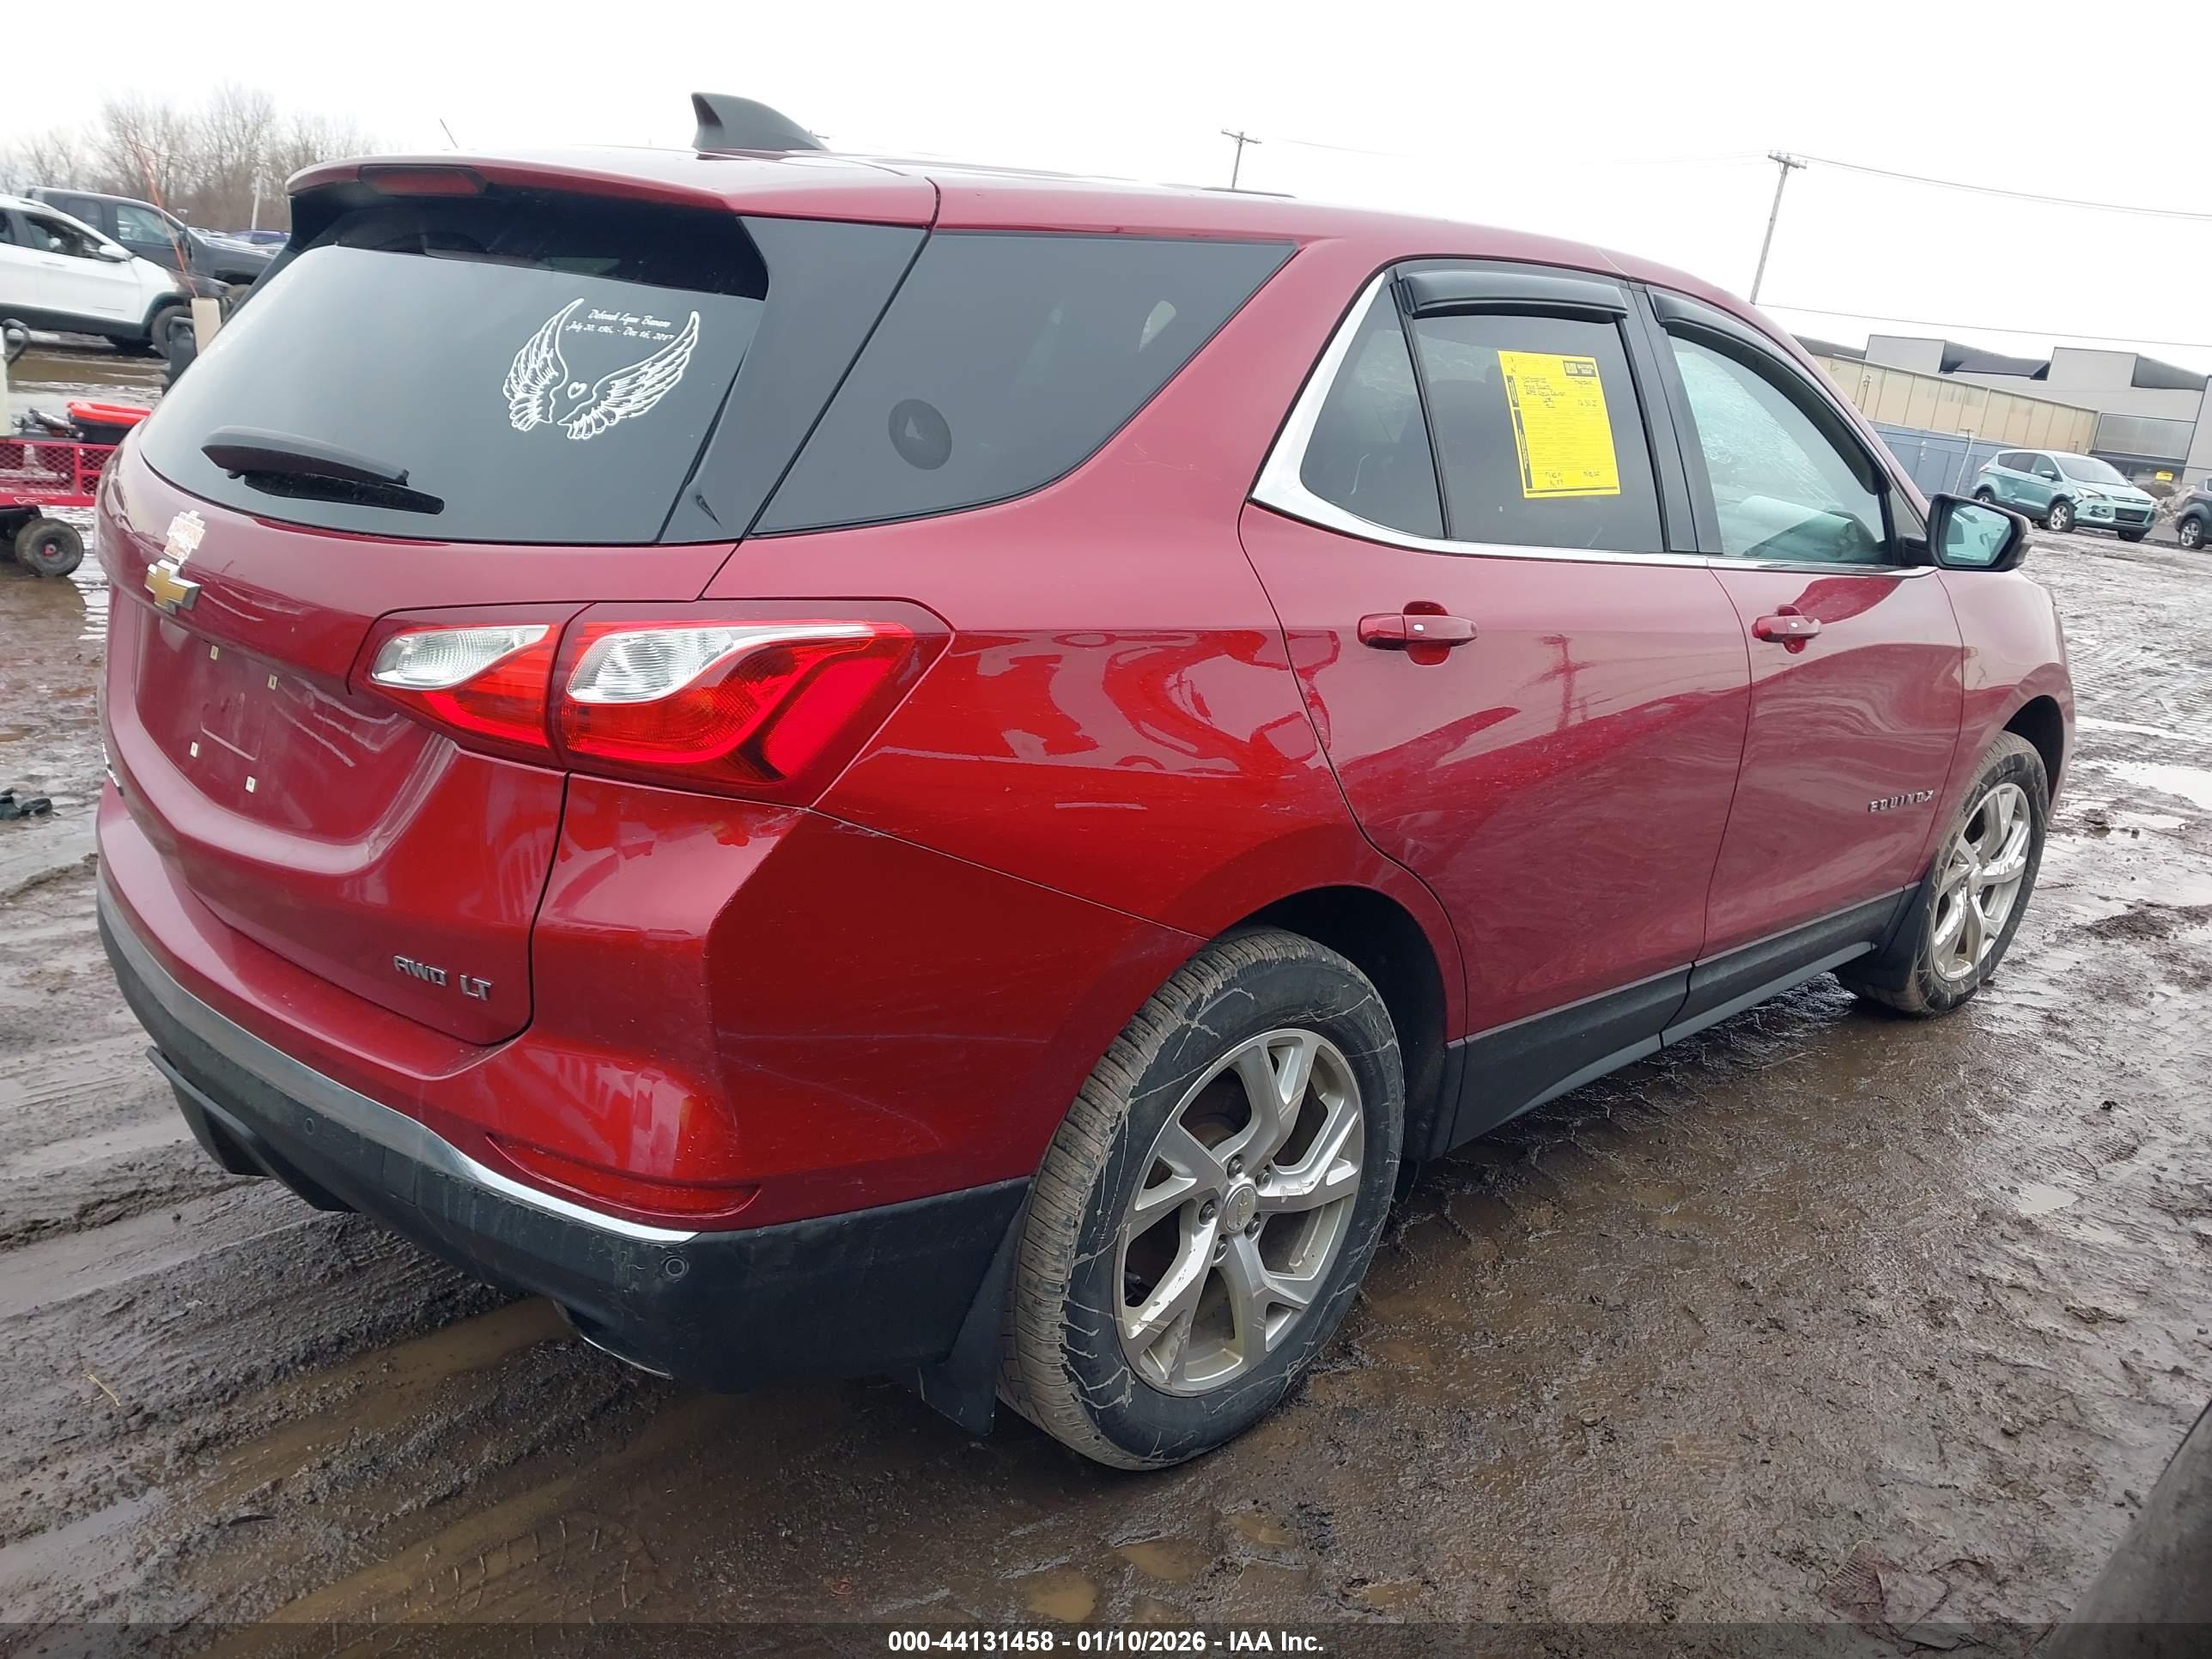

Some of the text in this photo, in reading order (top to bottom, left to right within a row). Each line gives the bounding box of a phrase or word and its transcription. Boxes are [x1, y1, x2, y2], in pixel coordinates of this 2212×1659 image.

[1869, 790, 1934, 812] EQUINOX
[393, 955, 494, 1001] AWD LT
